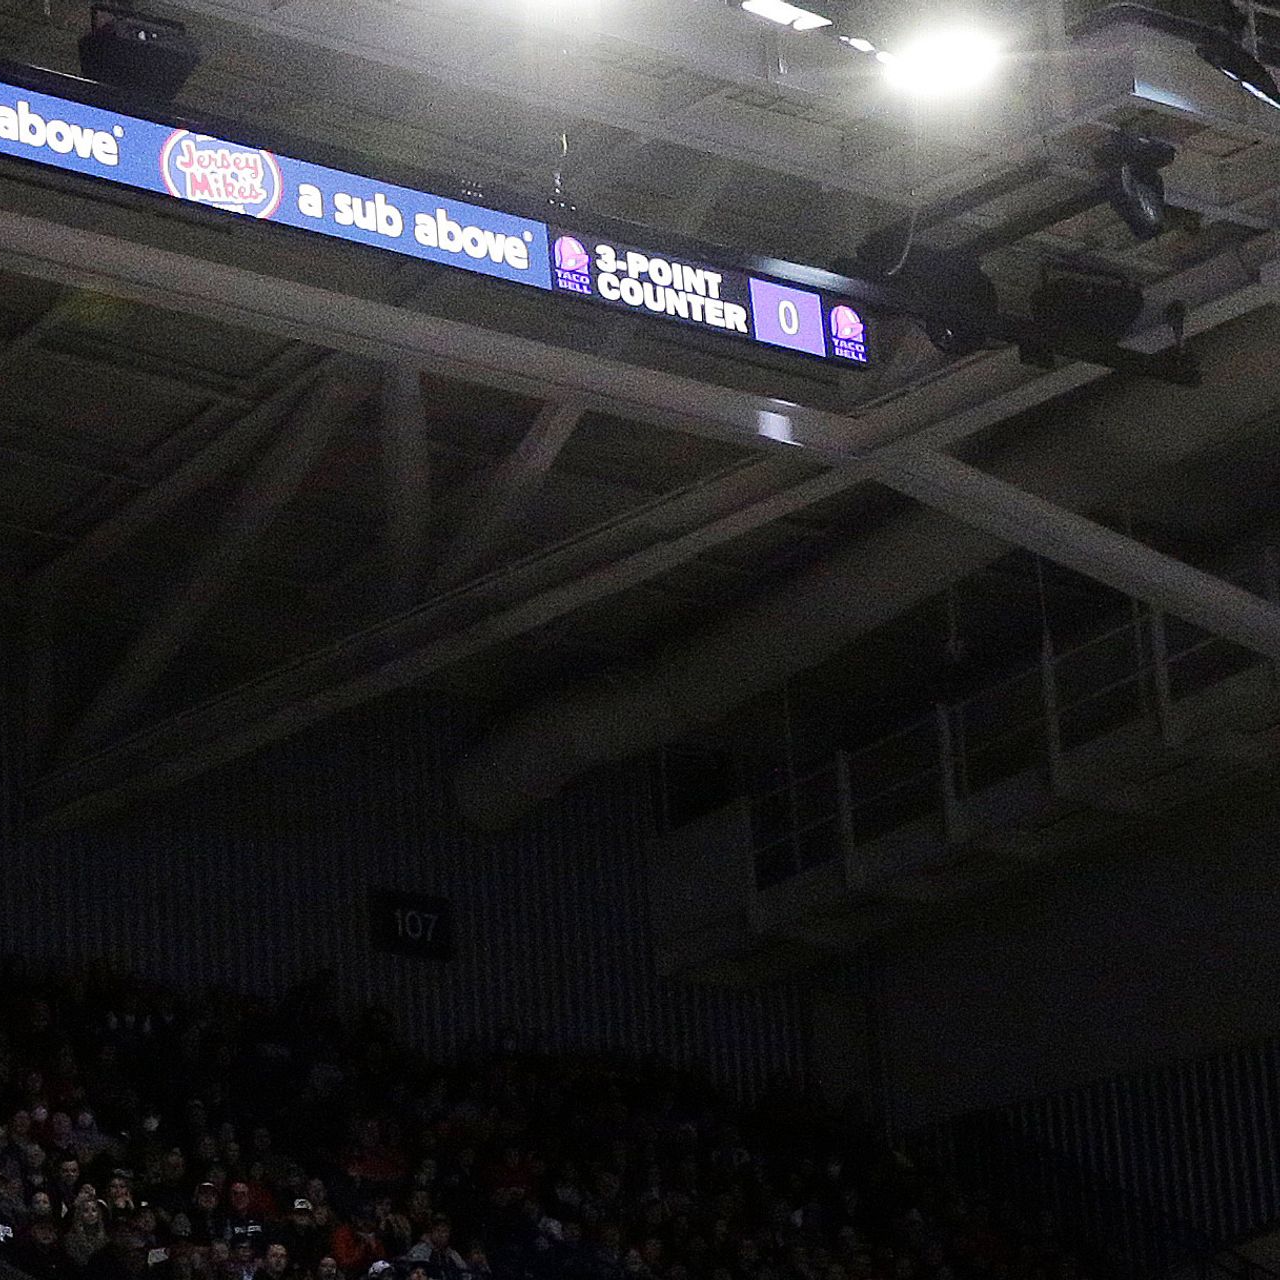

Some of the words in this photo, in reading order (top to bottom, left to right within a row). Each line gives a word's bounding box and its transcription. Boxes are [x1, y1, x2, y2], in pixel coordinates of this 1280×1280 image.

[178, 141, 262, 180] Jersey
[298, 183, 324, 218] a
[334, 193, 403, 237] sub
[414, 208, 530, 269] above
[555, 269, 590, 285] TACO
[595, 245, 722, 298] 3-POINT
[597, 272, 748, 333] COUNTER
[777, 300, 799, 335] 0
[831, 338, 865, 353] TACO
[394, 908, 438, 942] 107
